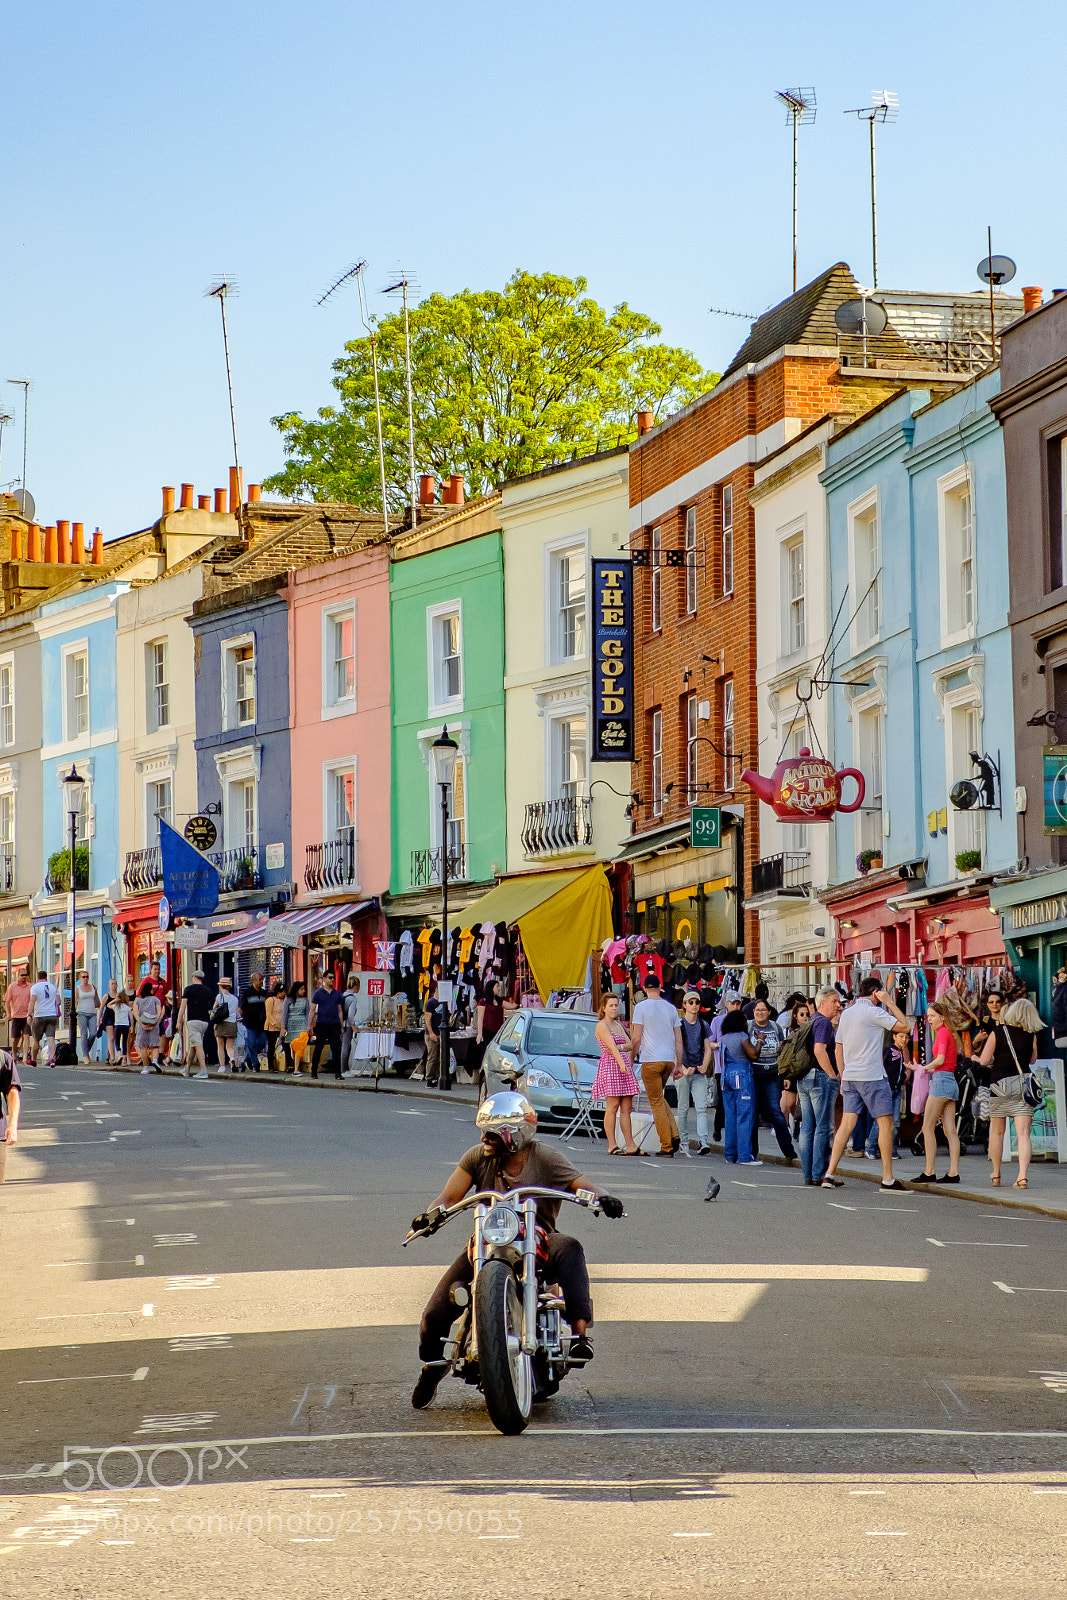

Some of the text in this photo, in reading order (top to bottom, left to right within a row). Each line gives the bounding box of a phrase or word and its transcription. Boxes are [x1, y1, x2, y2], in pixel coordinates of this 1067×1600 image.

[601, 570, 624, 626] THE
[601, 639, 624, 714] GOLD
[618, 729, 627, 738] &
[808, 777, 826, 792] 101
[785, 787, 837, 808] ARCADE
[695, 819, 716, 835] 99
[1012, 900, 1059, 929] HIGHLAND
